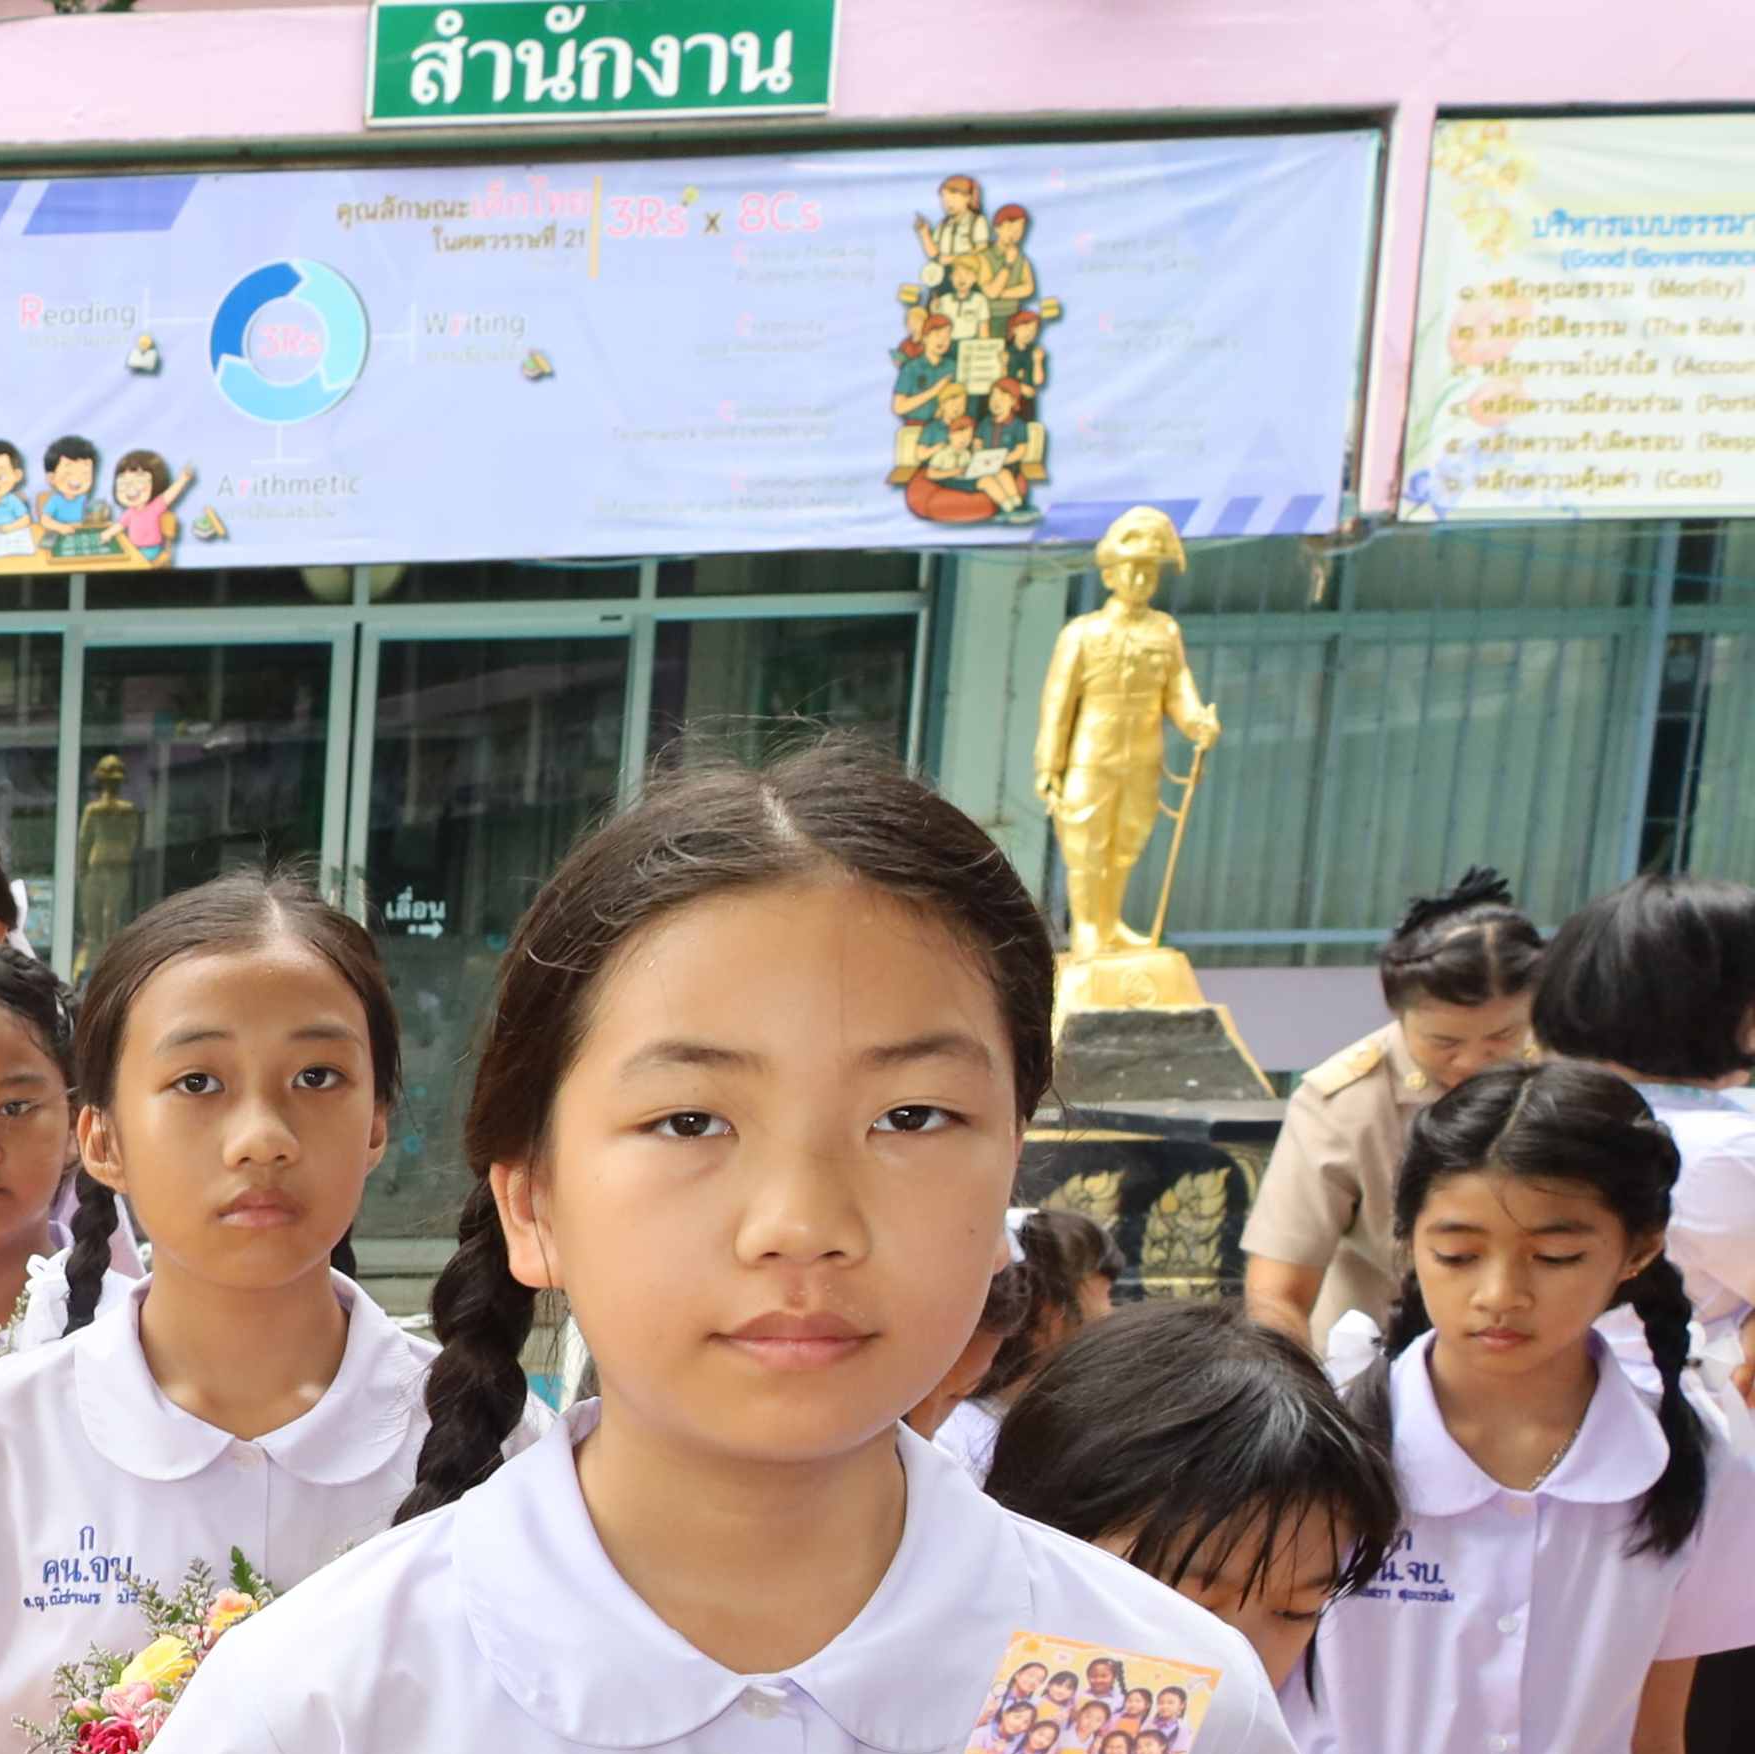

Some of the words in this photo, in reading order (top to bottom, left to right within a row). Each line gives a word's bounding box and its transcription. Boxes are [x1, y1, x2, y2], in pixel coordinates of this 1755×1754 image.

[408, 4, 794, 105] สำนักงาน
[605, 196, 689, 239] 3Rs
[736, 191, 824, 234] 8Cs
[563, 229, 587, 250] 21
[19, 293, 137, 331] Reading
[424, 311, 527, 338] Writing
[385, 885, 446, 920] เลื่อน
[79, 1525, 95, 1551] ก
